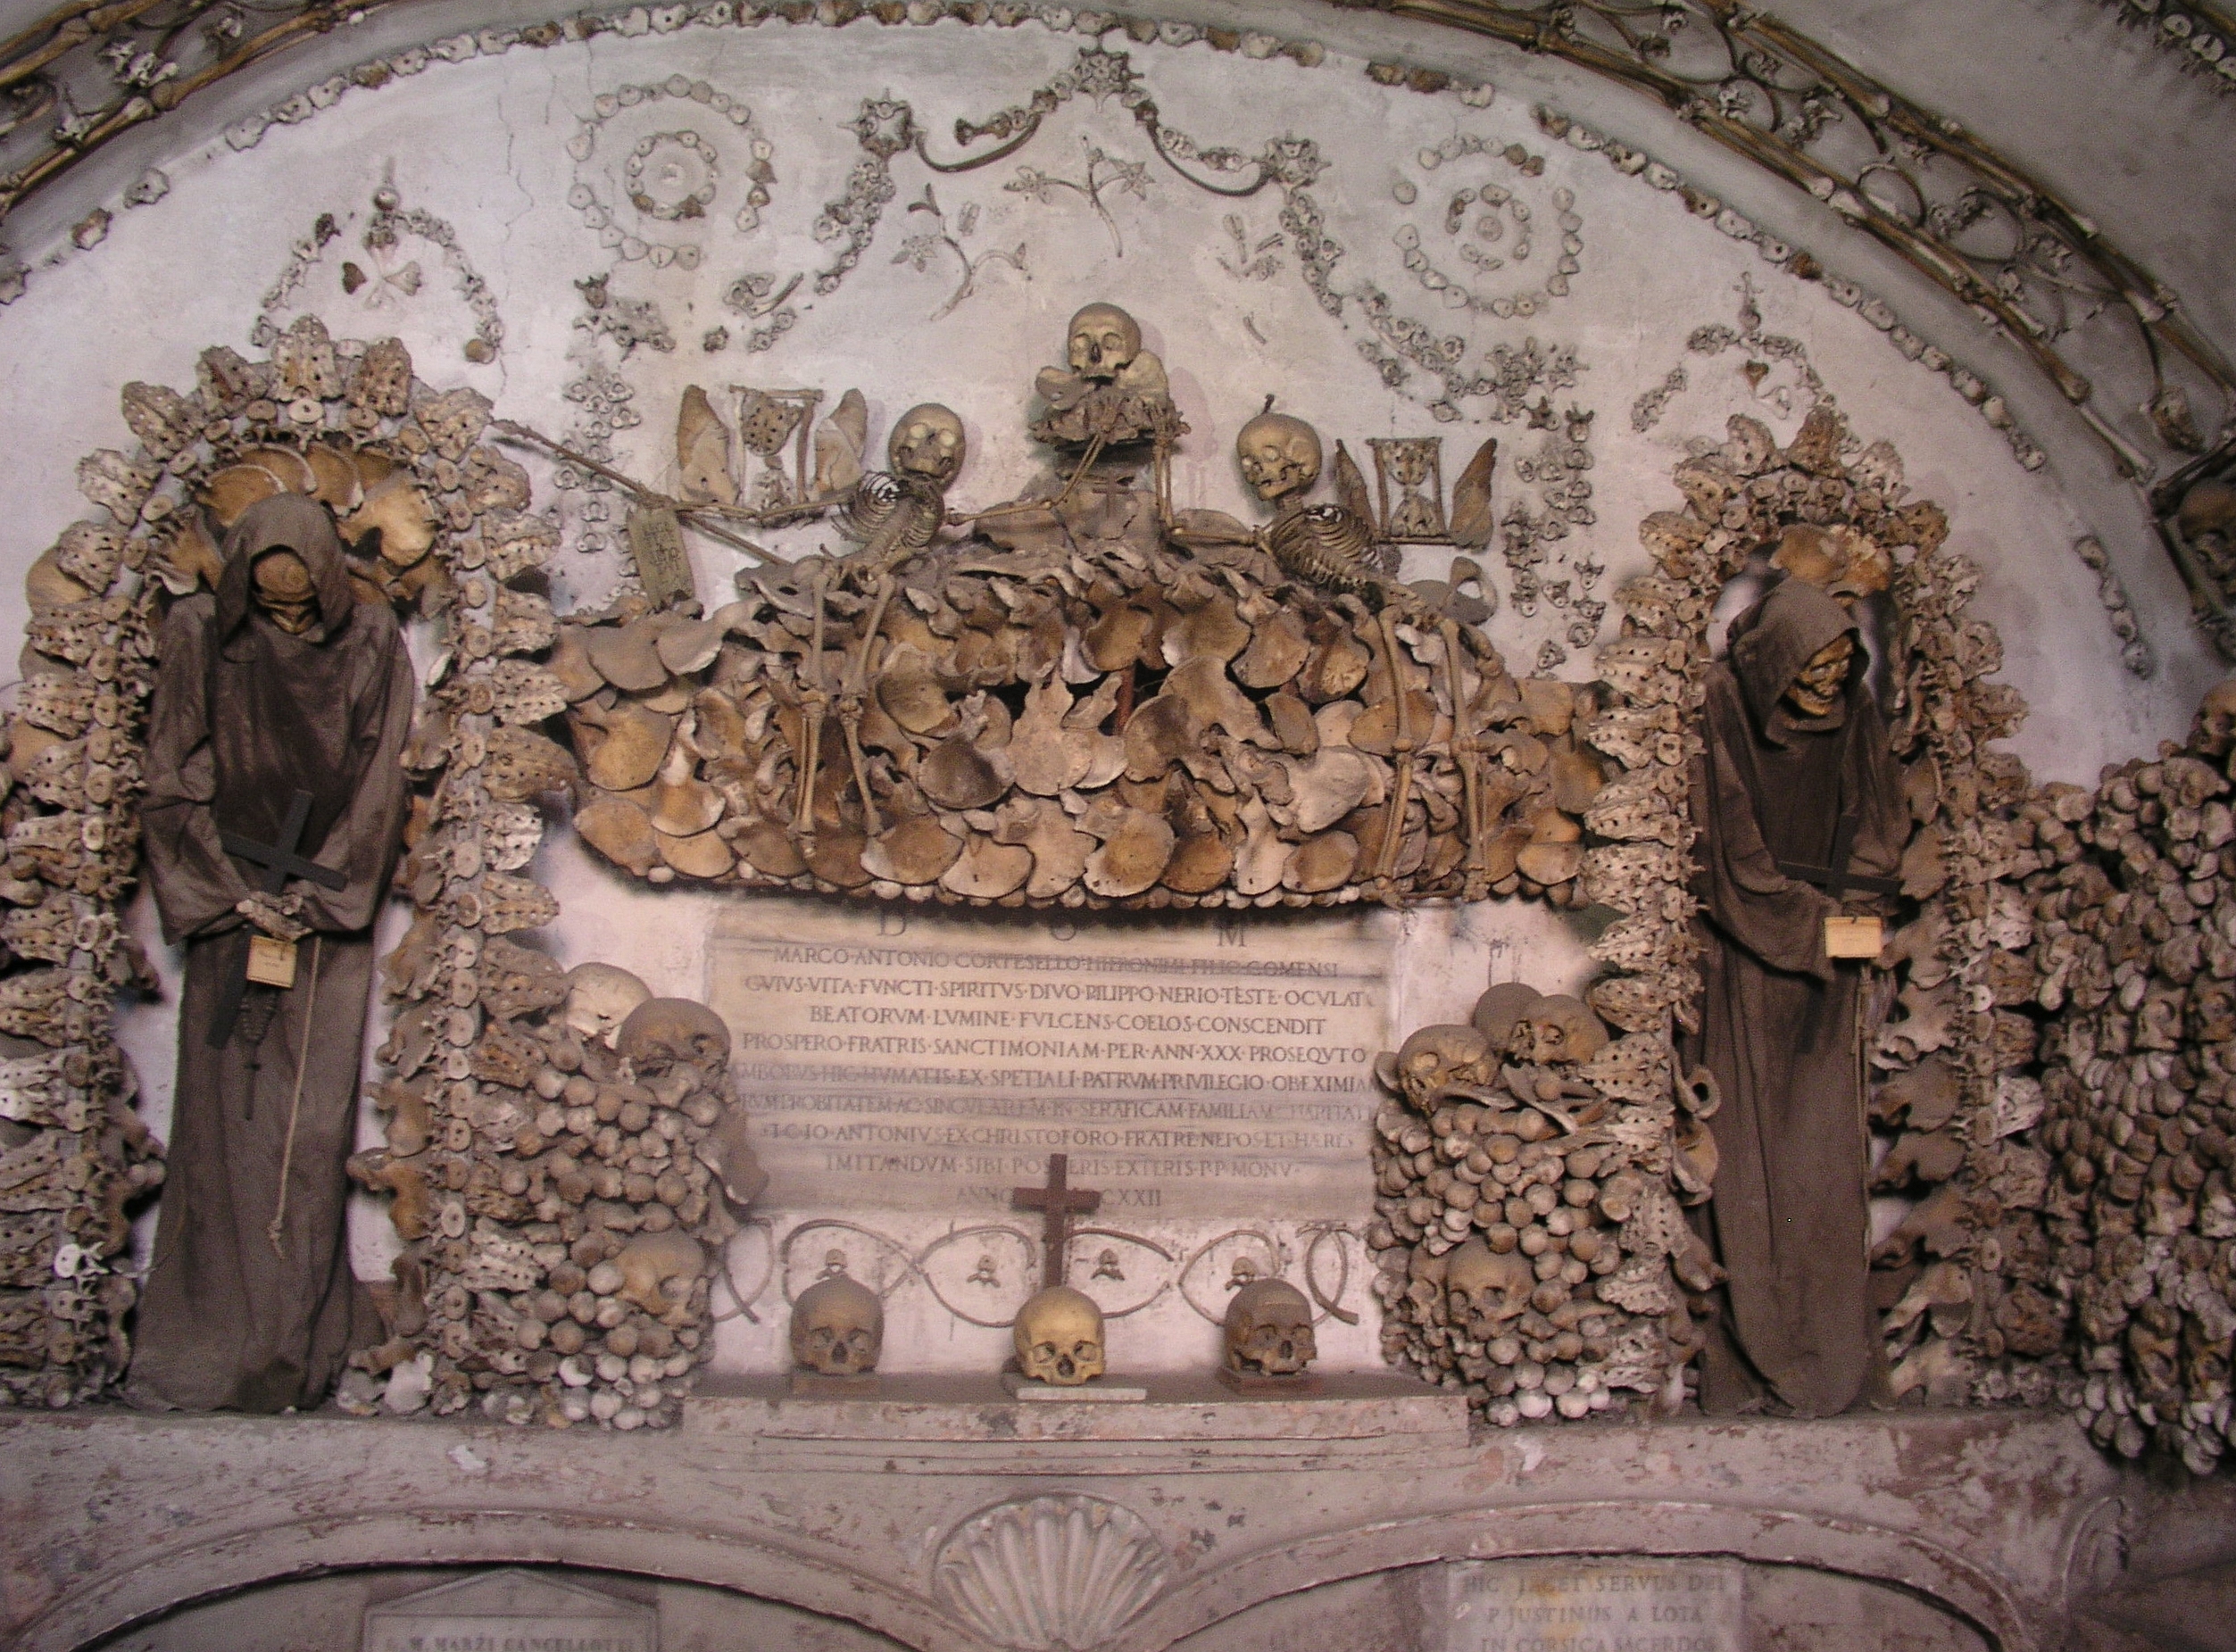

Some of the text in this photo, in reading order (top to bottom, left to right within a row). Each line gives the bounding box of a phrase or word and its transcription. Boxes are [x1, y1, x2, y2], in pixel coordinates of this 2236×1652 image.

[774, 946, 849, 965] MARCO
[854, 949, 950, 967] ANTONIO
[807, 976, 854, 994] VITA
[859, 978, 934, 996] FVNCTI
[939, 980, 1024, 999] SPIRITVS
[1030, 983, 1081, 1000] DIVO
[1160, 986, 1219, 1004] NERIO
[810, 1005, 925, 1025] BEATORVM
[933, 1009, 1011, 1027] LVMINE
[1116, 1014, 1192, 1033] COELOS
[1197, 1016, 1326, 1035] CONSCENDIT
[743, 1033, 1367, 1065] PROSPERO FRATRIS SANCTIMONIAM PER ANN XXX PROSEQVTO
[958, 1069, 984, 1085] EX
[1082, 1071, 1157, 1090] PATRVM
[1160, 1073, 1264, 1092] PRIVILEGIO
[972, 1128, 1118, 1146] CHRISTOFORO
[1012, 1158, 1109, 1175] POSERIS
